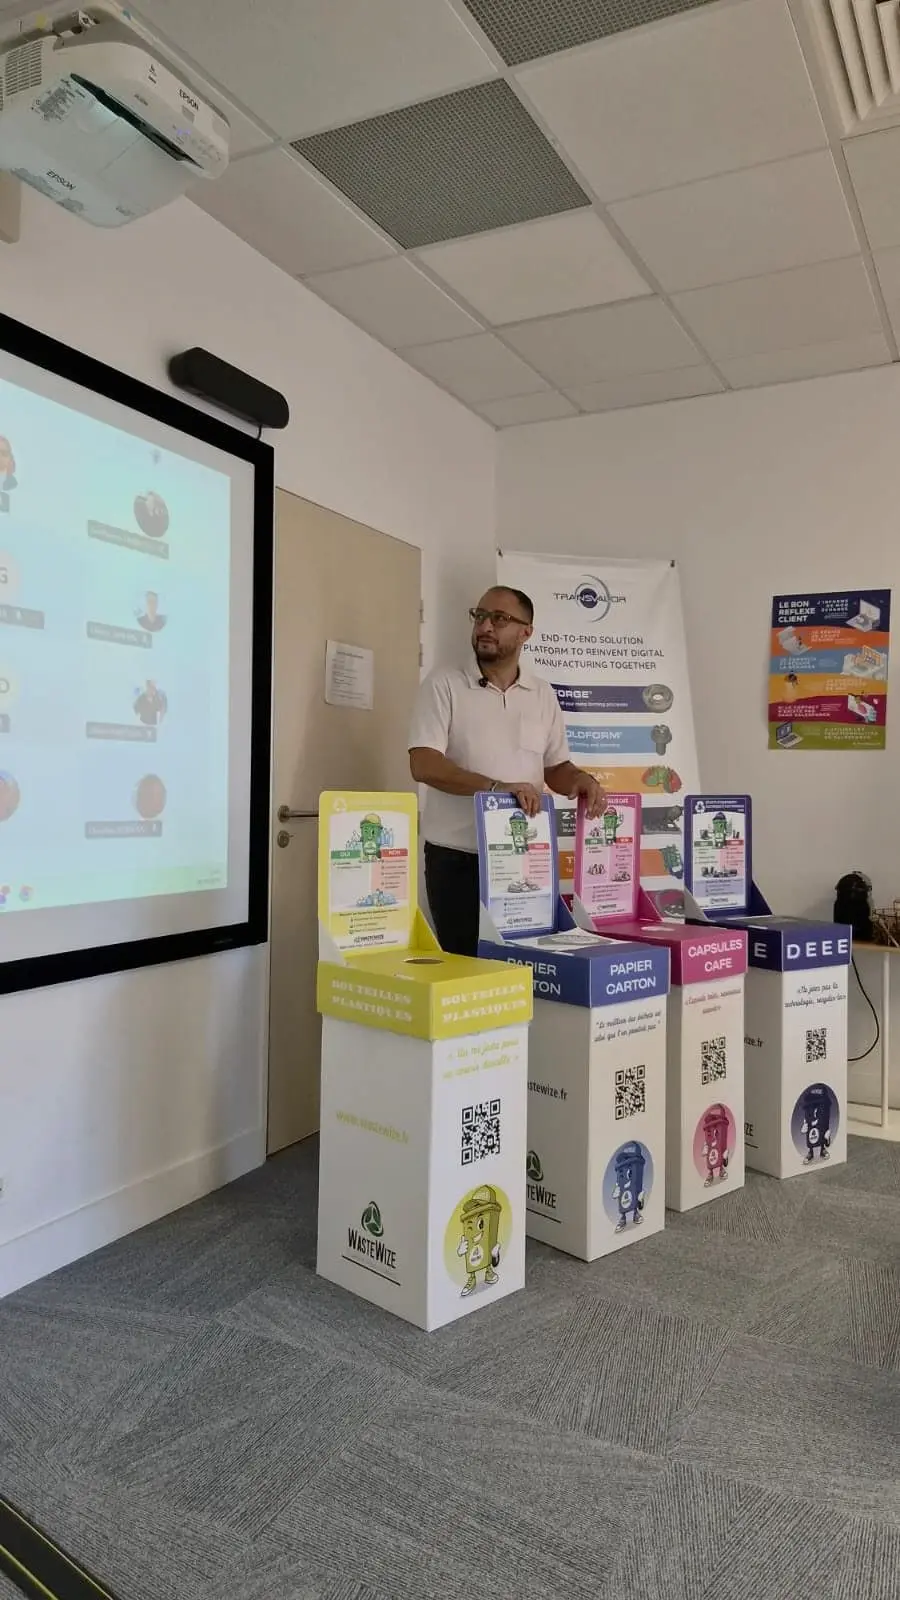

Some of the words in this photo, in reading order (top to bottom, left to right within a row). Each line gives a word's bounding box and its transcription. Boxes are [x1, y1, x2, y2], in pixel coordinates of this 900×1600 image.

[179, 88, 199, 111] EPSON
[46, 170, 77, 191] EPSON
[552, 592, 627, 603] TRANSVALOR
[790, 600, 809, 608] BON
[778, 607, 816, 616] REFLEXE
[778, 615, 809, 623] CLIENT
[541, 633, 597, 643] END-TO-END
[599, 635, 644, 645] SOLUTION
[523, 644, 569, 655] PLATFORM
[571, 647, 584, 656] TO
[586, 647, 629, 657] REINVENT
[630, 649, 665, 657] DIGITAL
[534, 657, 608, 669] MANUFACTURING
[610, 660, 657, 670] TOGETHER
[687, 939, 743, 958] CAPSULES
[610, 959, 653, 976] PAPIER
[704, 958, 733, 973] CAFE
[332, 979, 412, 1005] BOUTEILLES
[441, 983, 526, 1007] BOUTEILLES
[606, 976, 657, 995] CARTON
[332, 995, 413, 1022] PLASTIQUES
[443, 999, 527, 1023] PLASTIQUES
[528, 1081, 568, 1101] stewize.fr
[526, 1183, 557, 1209] TEWIZE
